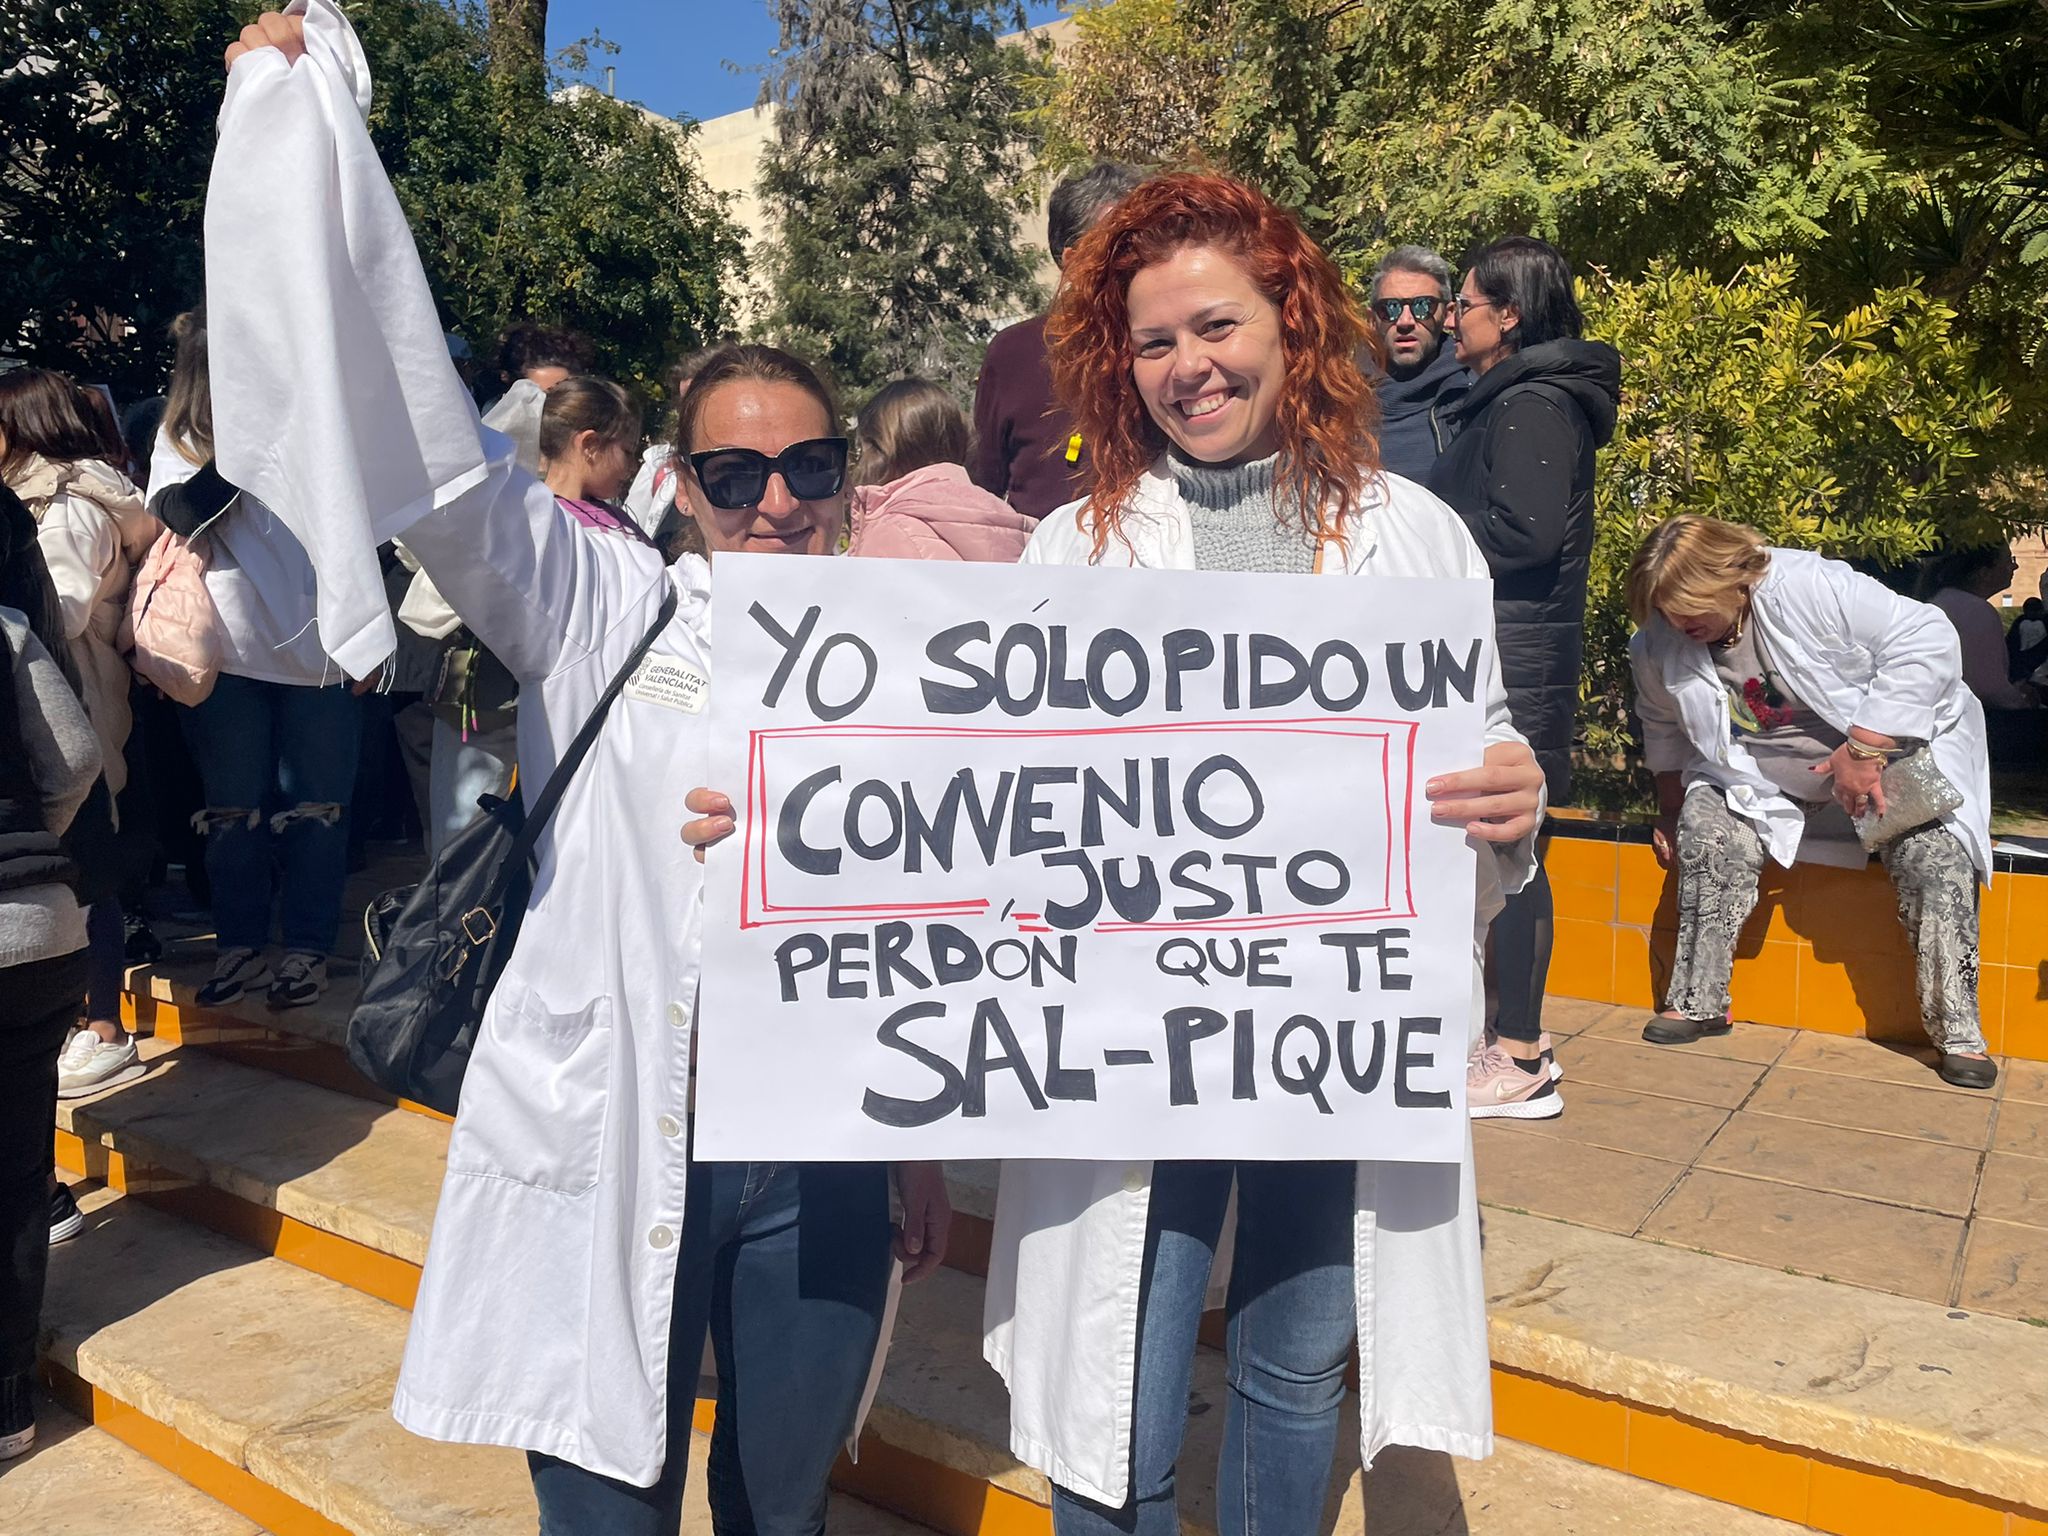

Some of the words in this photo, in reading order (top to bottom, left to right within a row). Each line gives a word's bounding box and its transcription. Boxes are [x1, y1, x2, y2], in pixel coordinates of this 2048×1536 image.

[644, 674, 698, 694] VALENCIANA
[649, 665, 710, 687] GENERALITAT
[748, 601, 878, 721] YO
[920, 599, 1151, 718] SÓLO
[1162, 629, 1369, 713] PIDO
[1385, 638, 1483, 712] UN
[777, 754, 1264, 876] CONVENIO
[1041, 849, 1351, 930] JUSTO
[773, 899, 1078, 1003] PERDÓN
[1155, 937, 1293, 988] QUE
[1319, 928, 1413, 993] TE
[861, 998, 1453, 1128] SAL-PIQUE
